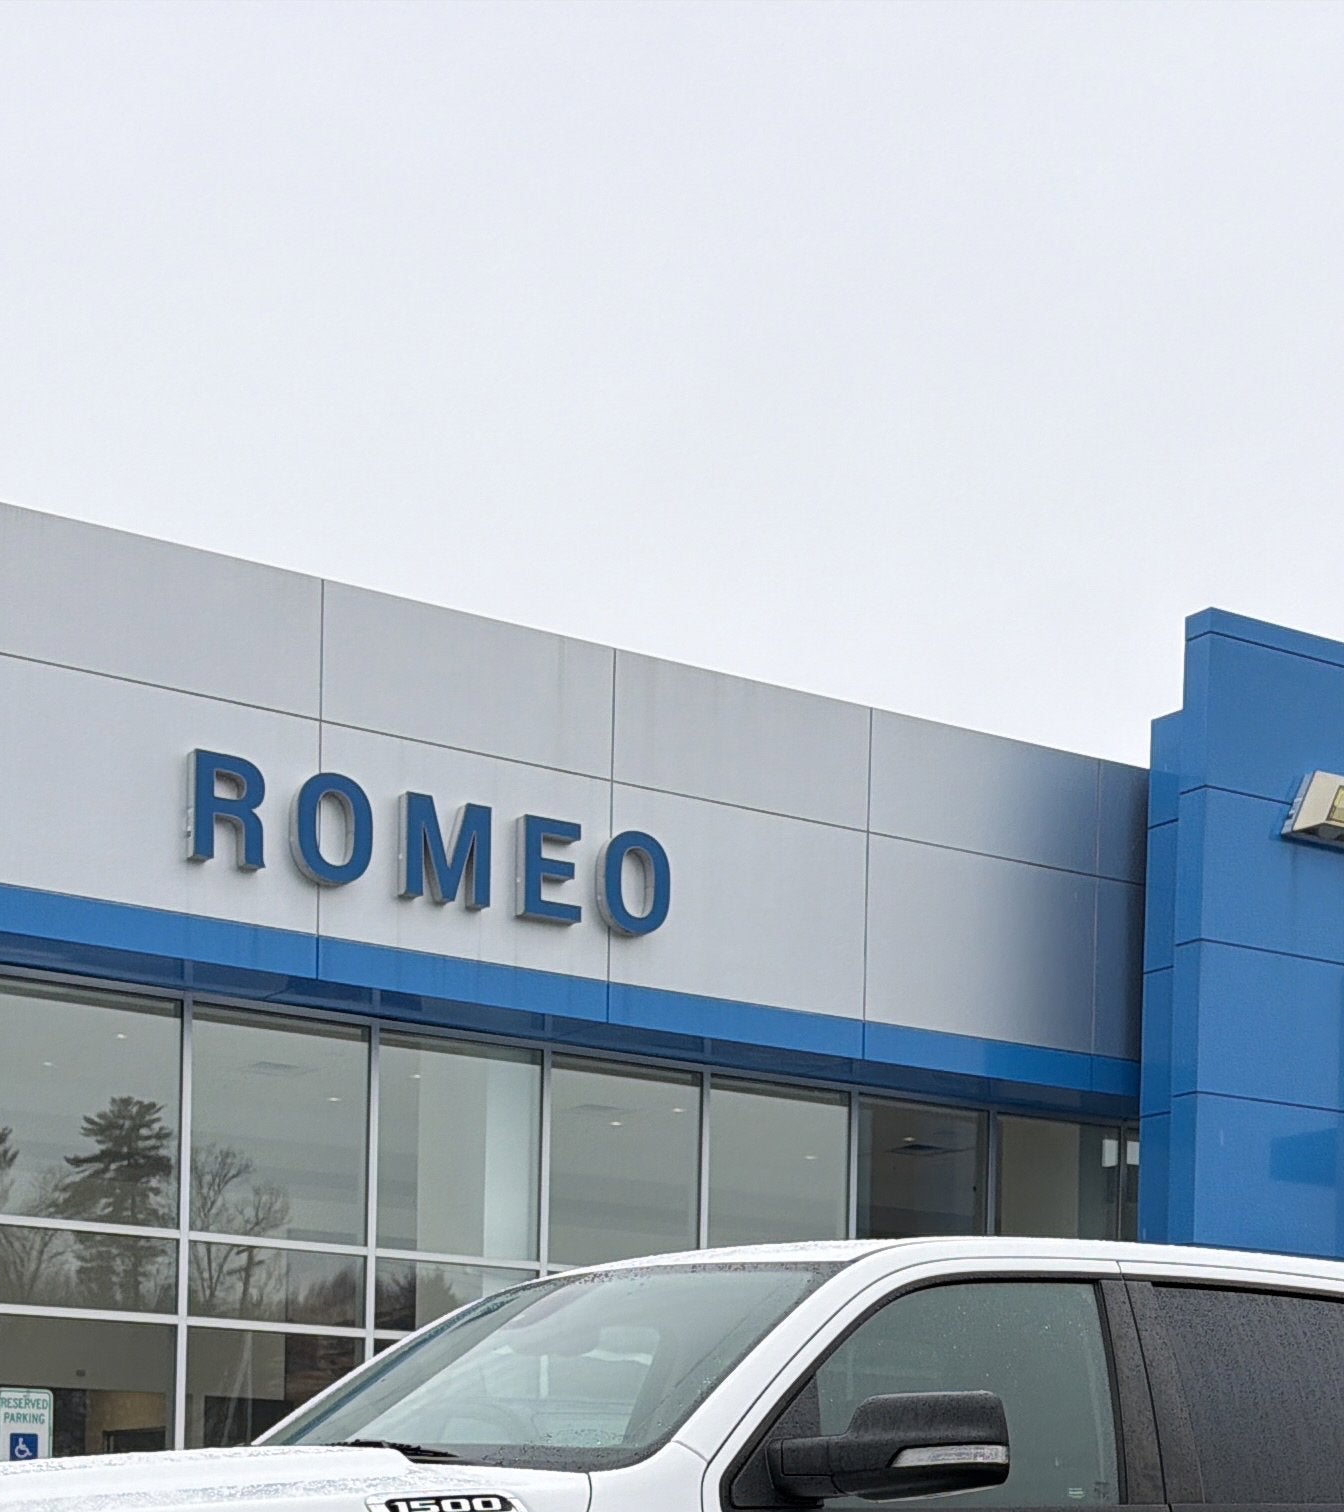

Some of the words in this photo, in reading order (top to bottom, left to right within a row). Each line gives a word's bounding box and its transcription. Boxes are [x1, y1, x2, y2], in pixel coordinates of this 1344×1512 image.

[187, 748, 671, 937] ROMEO
[0, 1397, 49, 1410] RESERVED
[3, 1411, 46, 1425] PARKING
